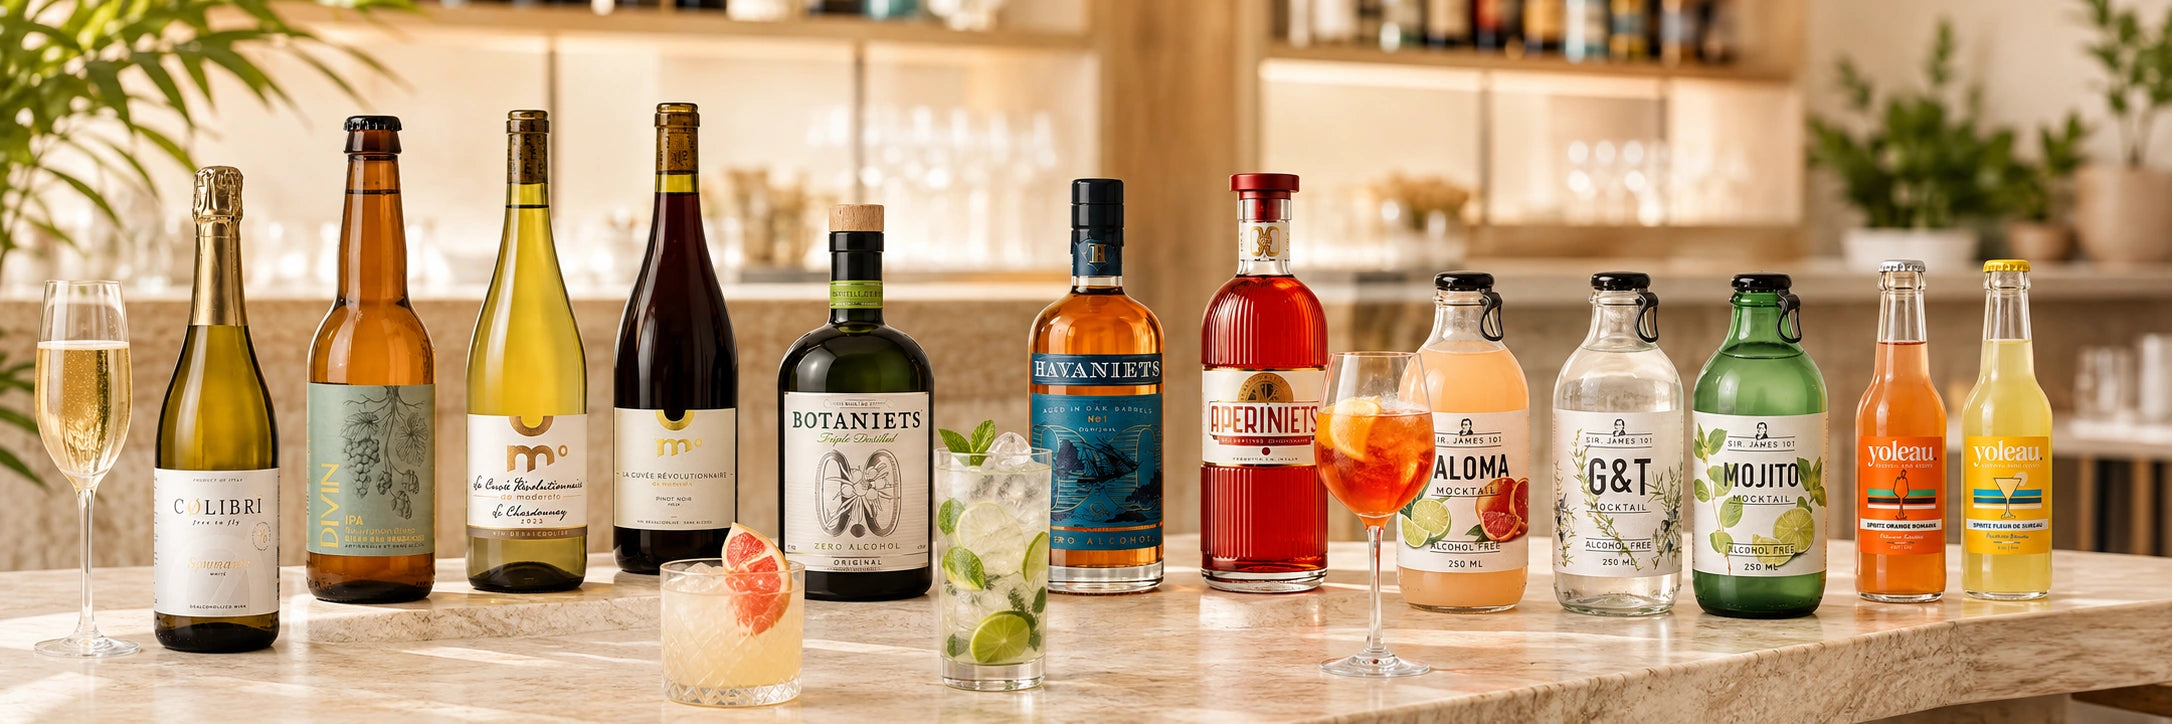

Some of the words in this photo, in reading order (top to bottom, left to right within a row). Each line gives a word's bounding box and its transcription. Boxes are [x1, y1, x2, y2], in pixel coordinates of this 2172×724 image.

[1034, 360, 1160, 379] HAVANIETS
[793, 411, 921, 430] BOTANIETS
[1211, 405, 1318, 433] APERINIETS
[1437, 436, 1450, 444] IR.
[1434, 454, 1509, 480] ALOMA
[631, 471, 655, 479] CUVÉE
[657, 472, 727, 480] RÉVOLUTIONNAIRE
[1589, 457, 1651, 496] G&T
[1724, 462, 1799, 488] MOJITO
[1436, 487, 1495, 495] MOCKTAIL
[1733, 495, 1790, 503] MOCKTAIL
[319, 463, 339, 548] DIVIN
[1591, 503, 1646, 511] MOCKTAIL
[345, 515, 364, 525] IPA
[1054, 536, 1075, 545] ERO
[1586, 541, 1625, 549] ALCOHOL
[1631, 541, 1651, 549] FREE
[814, 543, 842, 551] ZERO
[848, 543, 900, 551] ALCOHOL
[1431, 543, 1473, 551] ALCOHOL
[1728, 546, 1769, 554] ALCOHOL
[1744, 563, 1761, 571] 250
